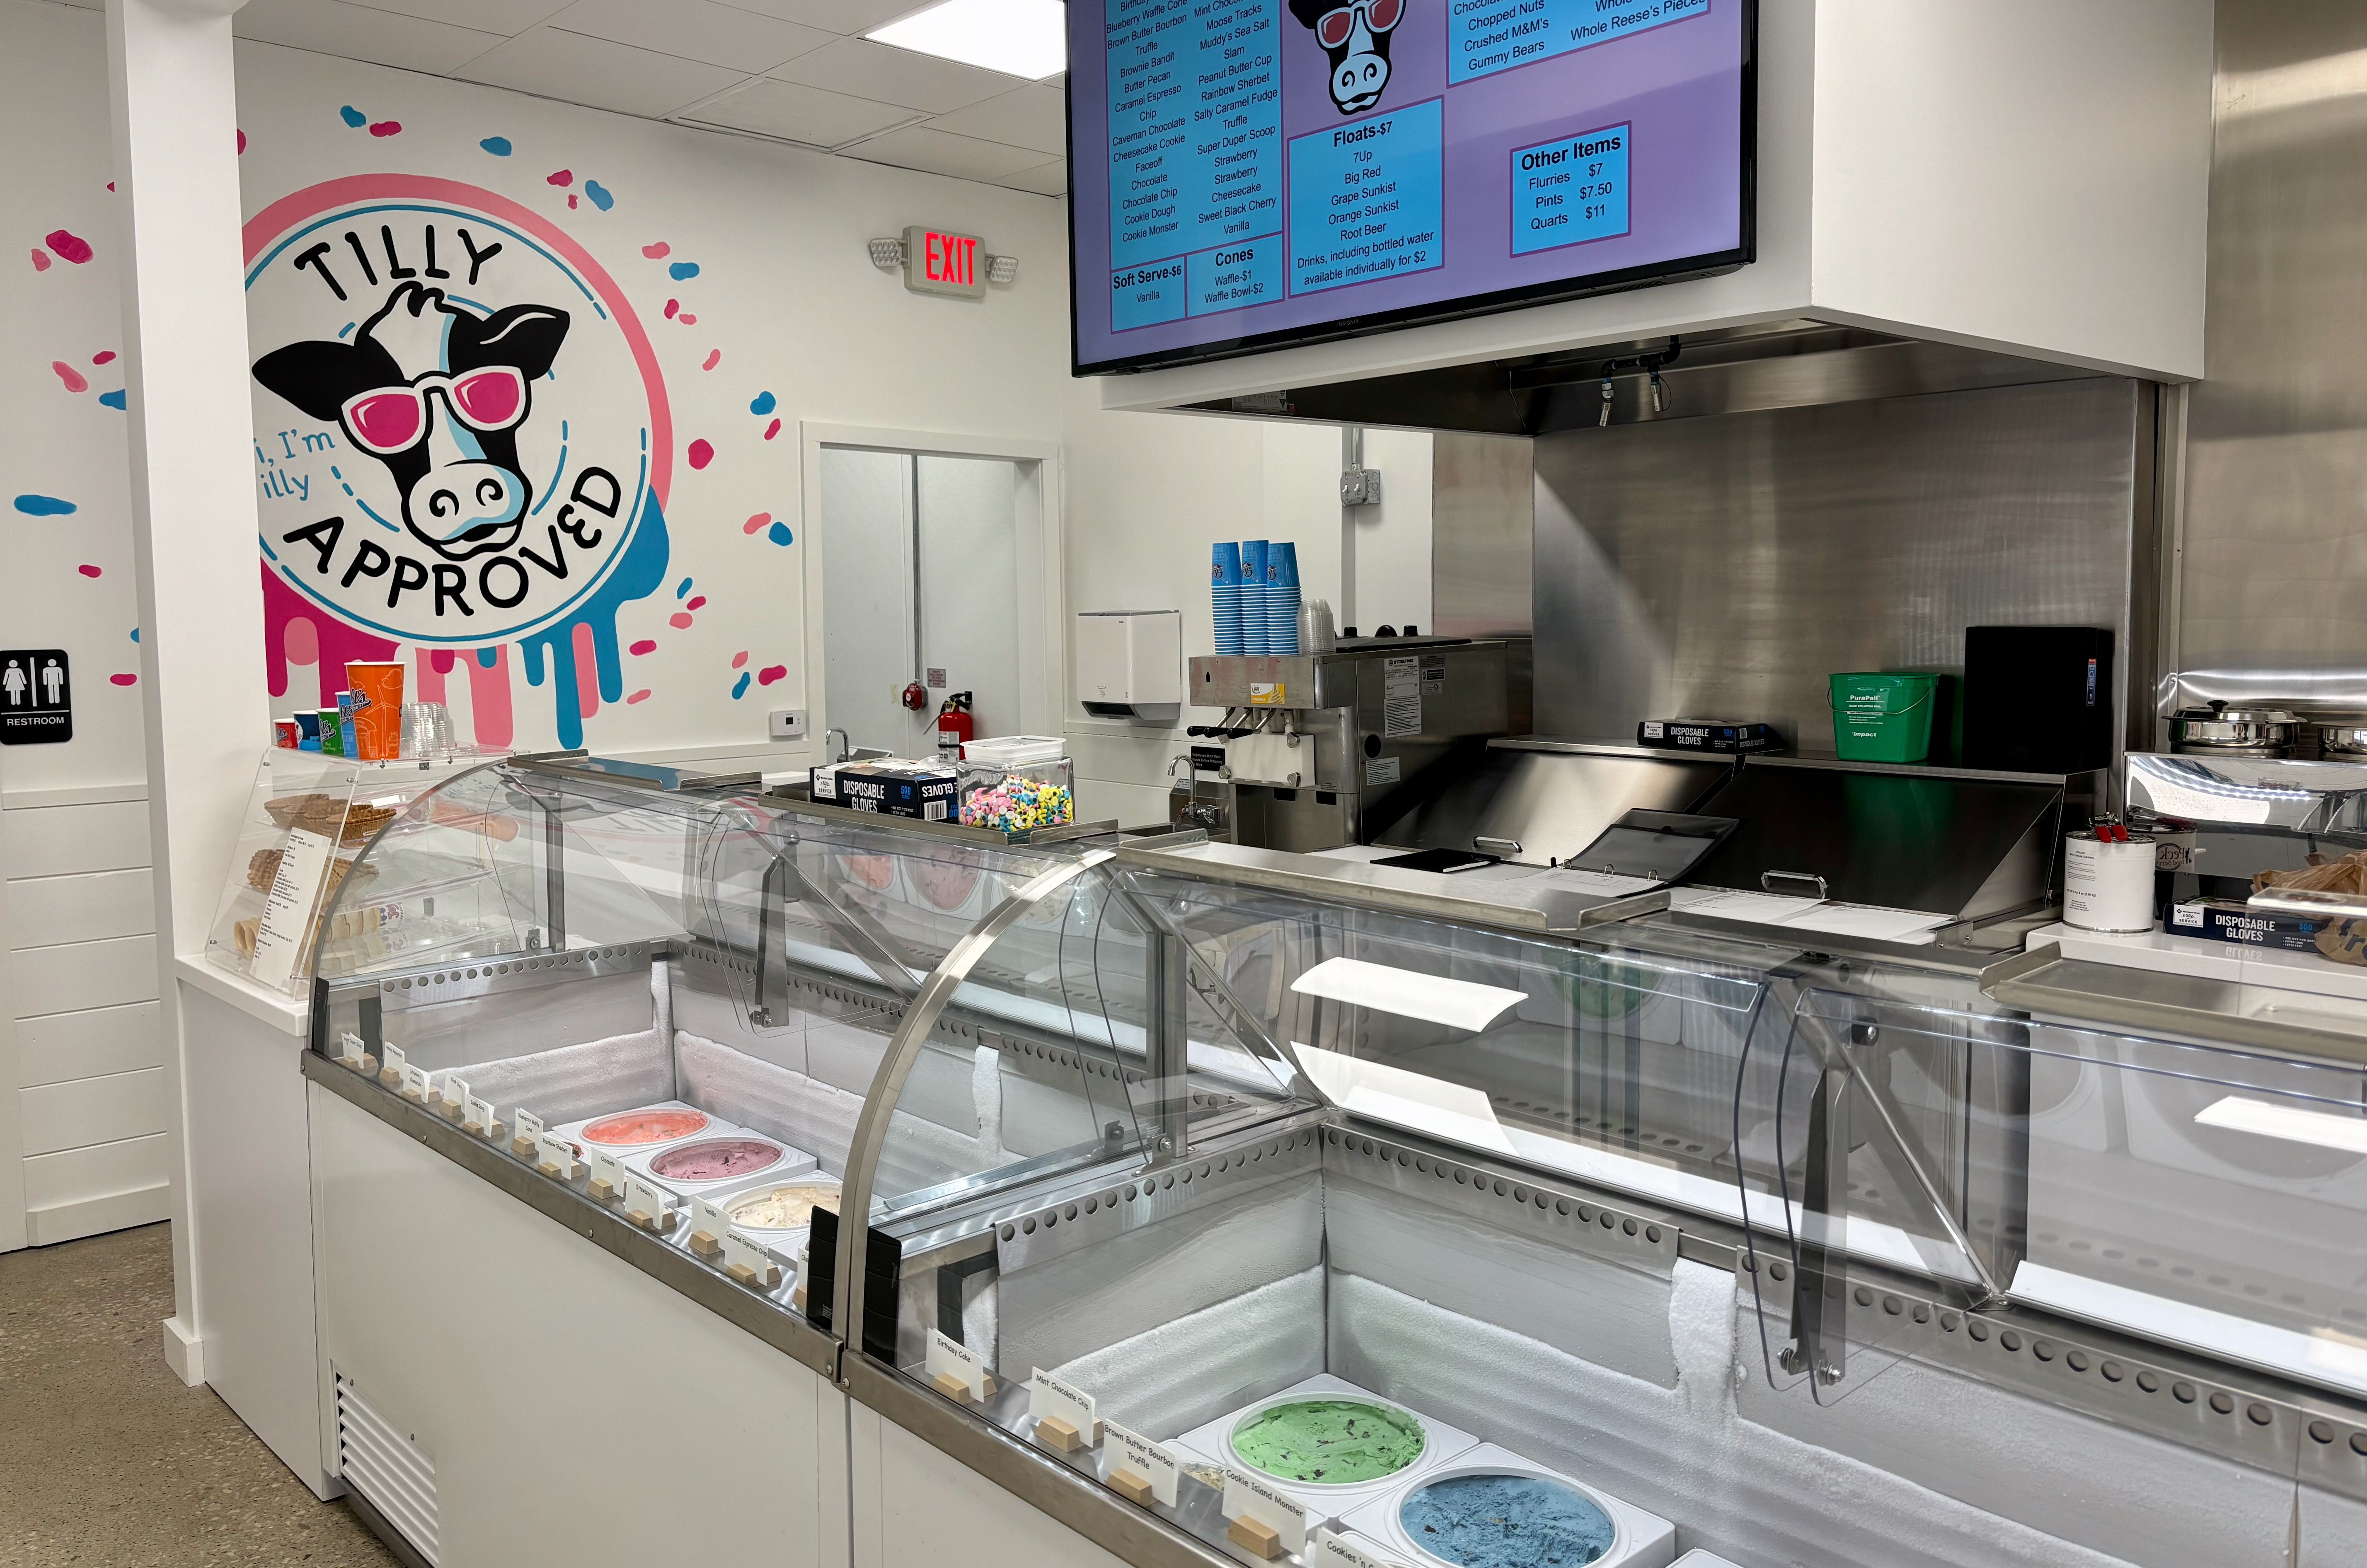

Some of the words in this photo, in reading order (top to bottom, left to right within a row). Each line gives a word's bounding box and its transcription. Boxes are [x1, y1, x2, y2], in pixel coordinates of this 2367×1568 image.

[1106, 14, 1140, 34] Blueberry
[1142, 5, 1165, 20] Waffle
[1167, 0, 1188, 10] Cone
[1194, 4, 1210, 18] Mint
[1206, 13, 1233, 31] Moose
[1235, 4, 1262, 21] Tracks
[1469, 6, 1516, 31] Chopped
[1519, 0, 1544, 15] Nuts
[1571, 22, 1607, 41] Whole
[1611, 5, 1660, 29] Reese's
[1107, 36, 1130, 50] Brown
[1132, 28, 1154, 41] Butter
[1155, 14, 1187, 32] Bourbon
[1200, 31, 1232, 51] Muddy's
[1235, 26, 1251, 39] Sea
[1254, 18, 1270, 32] Salt
[1464, 30, 1508, 52] Crushed
[1512, 17, 1549, 39] M&M's
[1135, 41, 1158, 56] Truffle
[1224, 46, 1244, 60] Slam
[1469, 51, 1509, 71] Gummy
[1513, 41, 1545, 58] Bears
[1120, 61, 1149, 78] Brownie
[1151, 51, 1175, 67] Bandit
[1198, 69, 1226, 86] Peanut
[1228, 60, 1253, 75] Butter
[1255, 54, 1272, 68] Cup
[1124, 80, 1146, 94] Butter
[1148, 71, 1171, 87] Pecan
[1201, 85, 1235, 102] Rainbow
[1237, 71, 1270, 91] Sherbet
[1115, 96, 1145, 113] Caramel
[1147, 85, 1181, 106] Espresso
[1194, 107, 1214, 122] Salty
[1215, 96, 1249, 115] Caramel
[1252, 88, 1278, 104] Fudge
[1140, 109, 1156, 122] Chip
[1223, 115, 1248, 130] Truffle
[1113, 129, 1147, 147] Caveman
[1149, 117, 1186, 136] Chocolate
[1197, 142, 1220, 155] Super
[1222, 135, 1247, 150] Duper
[1249, 125, 1275, 140] Scoop
[1334, 121, 1393, 147] Floats-$7
[1113, 142, 1158, 163] Cheesecake
[1160, 134, 1186, 150] Cookie
[1214, 148, 1258, 168] Strawberry
[1353, 150, 1372, 163] 7Up
[1521, 149, 1569, 171] Other
[1573, 136, 1621, 159] Items
[1135, 156, 1163, 173] Faceoff
[1214, 166, 1258, 185] Strawberry
[1345, 172, 1360, 185] Big
[1362, 165, 1381, 180] Red
[1529, 172, 1570, 190] Flurries
[1588, 162, 1603, 178] $7
[1131, 173, 1167, 191] Chocolate
[1212, 181, 1261, 203] Cheesecake
[1331, 192, 1359, 207] Grape
[1362, 181, 1396, 199] Sunkist
[1122, 193, 1159, 210] Chocolate
[1160, 187, 1178, 200] Chip
[1536, 193, 1563, 209] Pints
[1580, 181, 1612, 201] $7.50
[1125, 211, 1150, 225] Cookie
[1152, 204, 1176, 219] Dough
[1198, 209, 1222, 224] Sweet
[1225, 203, 1246, 217] Black
[1249, 196, 1276, 211] Cherry
[1329, 210, 1363, 225] Orange
[1365, 199, 1399, 216] Sunkist
[1531, 213, 1568, 230] Quarts
[1585, 204, 1605, 220] $11
[1122, 227, 1147, 242] Cookie
[1149, 221, 1179, 236] Monster
[1223, 220, 1250, 235] Vanilla
[1341, 227, 1363, 242] Root
[1364, 222, 1387, 236] Beer
[925, 231, 976, 286] EXIT
[1215, 249, 1254, 267] Cones
[1297, 254, 1327, 269] Drinks,
[1330, 245, 1370, 262] including
[1372, 236, 1404, 253] bottled
[1407, 231, 1435, 245] water
[293, 225, 503, 301] TILLY
[1304, 268, 1343, 286] available
[1346, 257, 1396, 277] individually
[1399, 253, 1411, 266] for
[1414, 250, 1426, 264] $2
[1113, 273, 1135, 289] Soft
[1138, 264, 1182, 284] Serve-$6
[1215, 269, 1252, 287] Waffle-$1
[1136, 290, 1160, 303] Vanilla
[1204, 289, 1229, 304] Waffle
[1231, 283, 1264, 299] Bowl-$2
[278, 429, 336, 459] I'm
[260, 469, 309, 501] illy
[282, 466, 621, 616] APPROVED
[7, 716, 64, 726] RESTROOM
[1670, 727, 1709, 737] DISPOSABLE
[1677, 736, 1701, 745] GLOVES
[843, 780, 885, 800] DISPOSABLE
[901, 785, 911, 795] 500
[922, 782, 954, 797] GLOVES
[852, 797, 878, 813] GLOVES
[2215, 915, 2275, 932] DISPOSABLE
[2226, 927, 2263, 941] GLOVES
[518, 1112, 531, 1124] Blueberry
[542, 1137, 556, 1148] Rainbow
[556, 1143, 567, 1154] Sherbet
[601, 1156, 615, 1167] Chocolate
[636, 1184, 653, 1199] Strawberry
[705, 1207, 716, 1218] Vanilla
[726, 1231, 741, 1243] Caramel
[742, 1239, 758, 1252] Espresso
[759, 1248, 767, 1258] Chip
[937, 1338, 958, 1357] Birthday
[958, 1351, 971, 1363] Cake
[1036, 1373, 1050, 1387] Mint
[1051, 1382, 1077, 1402] Chocolate
[1078, 1397, 1089, 1411] Chip
[1104, 1424, 1123, 1441] Brown
[1125, 1435, 1147, 1452] Butter
[1148, 1447, 1174, 1469] Bourbon
[1127, 1451, 1150, 1469] Truffle
[1226, 1469, 1249, 1487] Cookie
[1251, 1482, 1273, 1500] Island
[1275, 1495, 1304, 1517] Monster
[1327, 1541, 1356, 1563] Cookies
